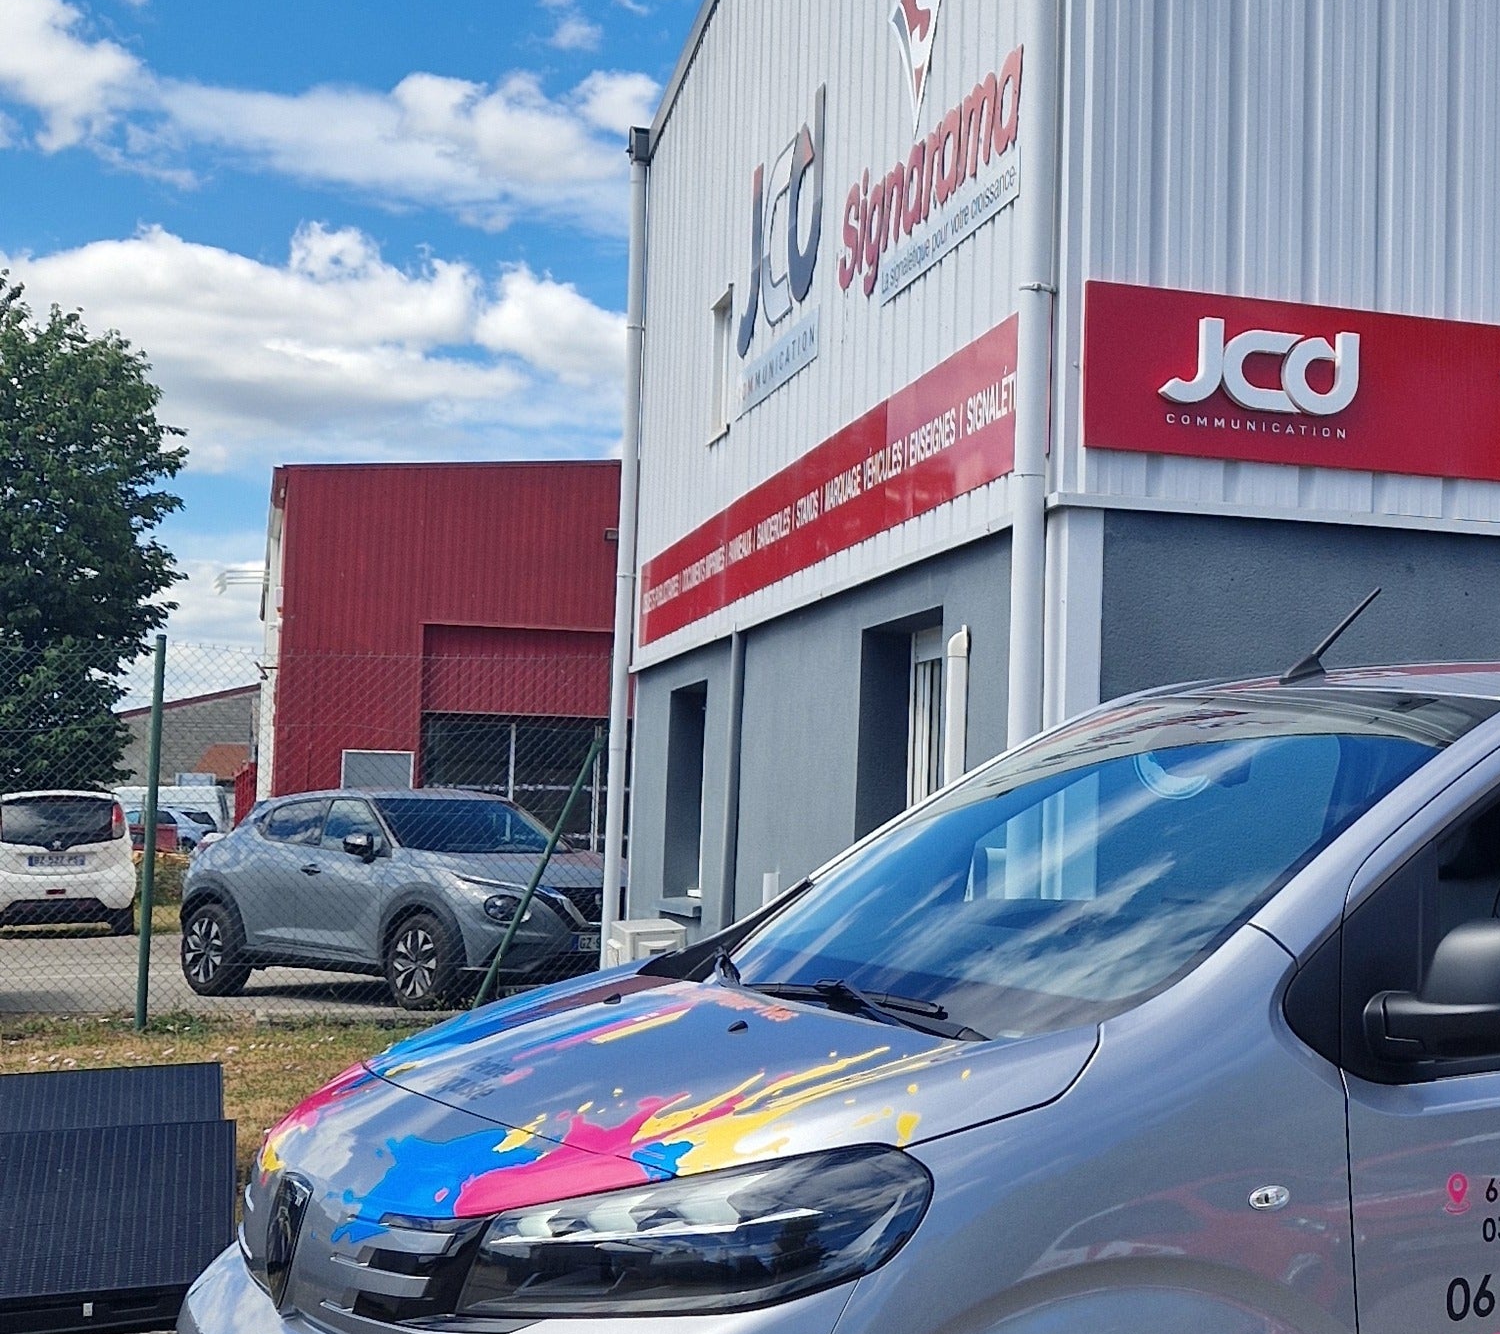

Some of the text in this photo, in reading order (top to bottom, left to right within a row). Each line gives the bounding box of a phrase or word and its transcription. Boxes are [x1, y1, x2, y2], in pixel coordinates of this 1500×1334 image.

[838, 43, 1024, 297] Signarama
[931, 222, 949, 258] pour
[950, 204, 970, 237] votre
[1165, 413, 1348, 440] COMMUNICATION
[796, 488, 819, 529] STANDS
[825, 464, 862, 513] MARQUAGE
[863, 438, 904, 491] VÉHICULES
[910, 407, 956, 467] ENSEIGNES
[1446, 1273, 1495, 1322] 06
